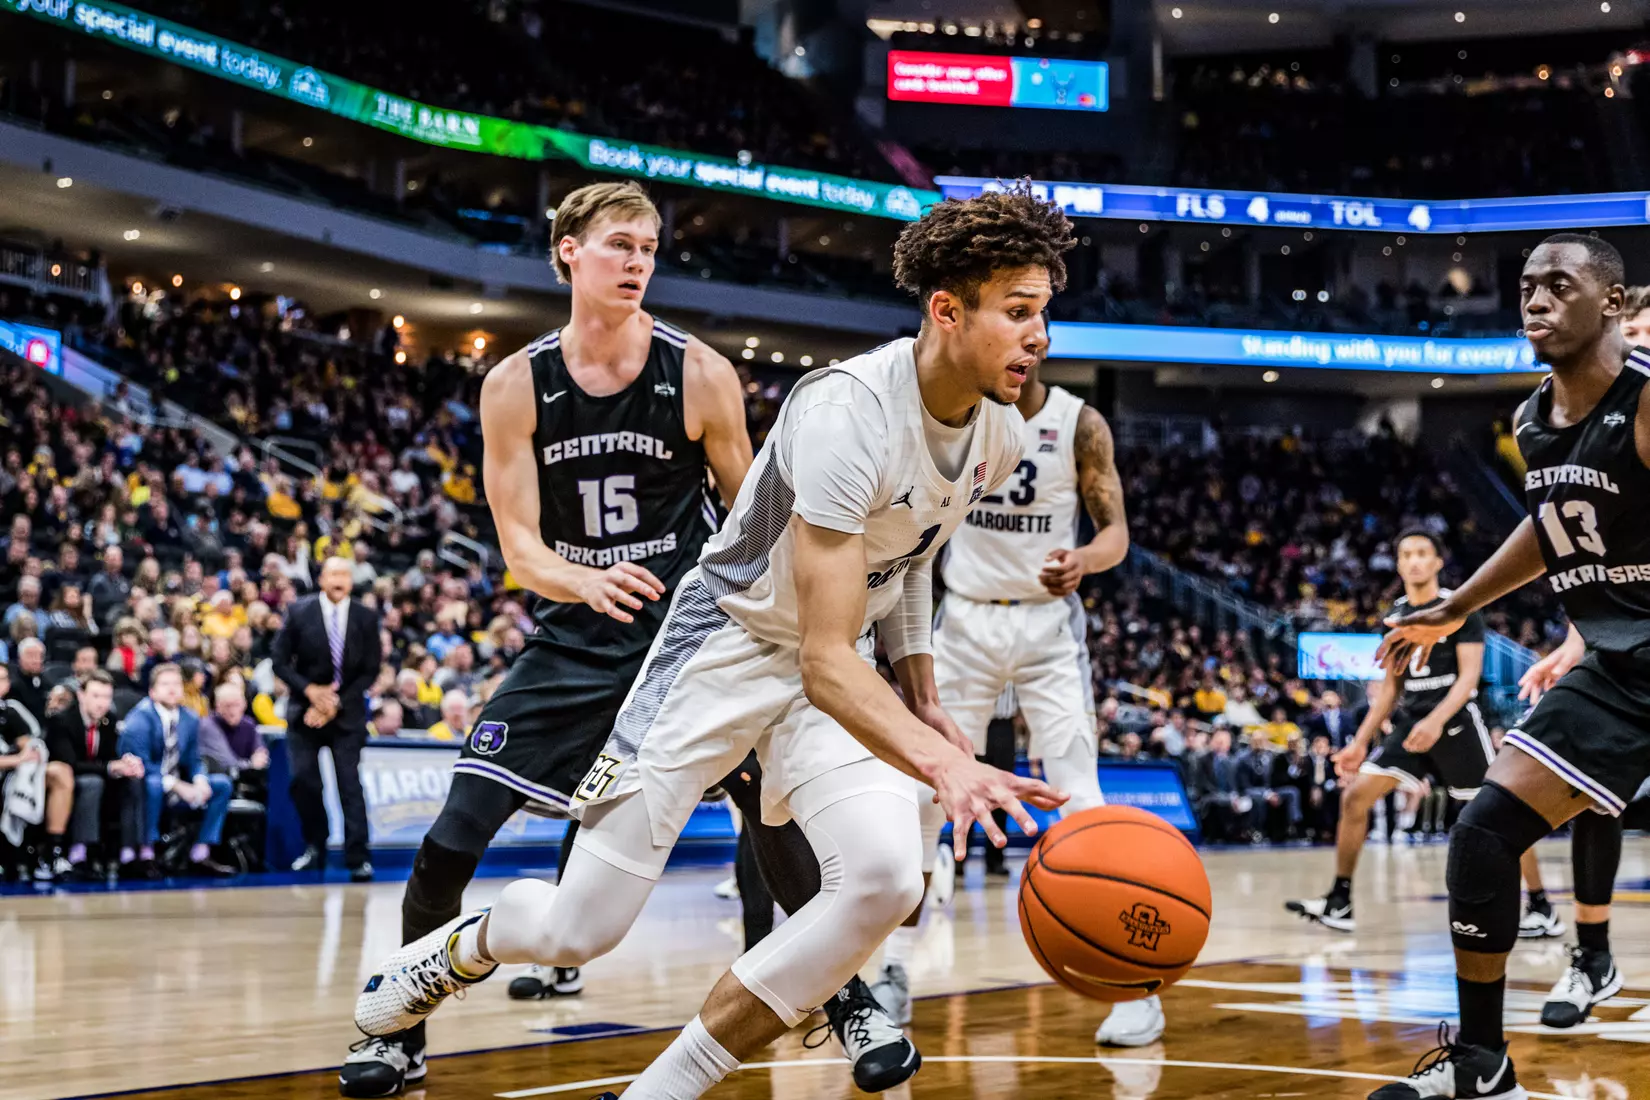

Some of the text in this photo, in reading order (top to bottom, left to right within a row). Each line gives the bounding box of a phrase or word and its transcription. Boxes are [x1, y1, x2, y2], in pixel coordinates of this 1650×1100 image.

[74, 3, 156, 47] special
[157, 30, 219, 68] event
[589, 139, 645, 172] Book
[644, 153, 694, 178] your
[694, 160, 765, 191] special
[765, 173, 819, 199] event
[1176, 193, 1227, 219] FLS
[1247, 196, 1269, 223] 4
[1328, 200, 1382, 227] TOL
[1408, 204, 1432, 231] 4
[1242, 335, 1331, 365] Standing
[1334, 338, 1381, 360] with
[1382, 344, 1421, 368] you
[1423, 340, 1453, 365] for
[1456, 345, 1518, 371] every
[543, 431, 673, 466] CENTRAL
[979, 459, 1037, 507] 3
[1525, 463, 1620, 494] ENTRAL
[577, 474, 640, 538] 15
[555, 532, 677, 567] ARKANSAS
[1538, 499, 1607, 558] 13
